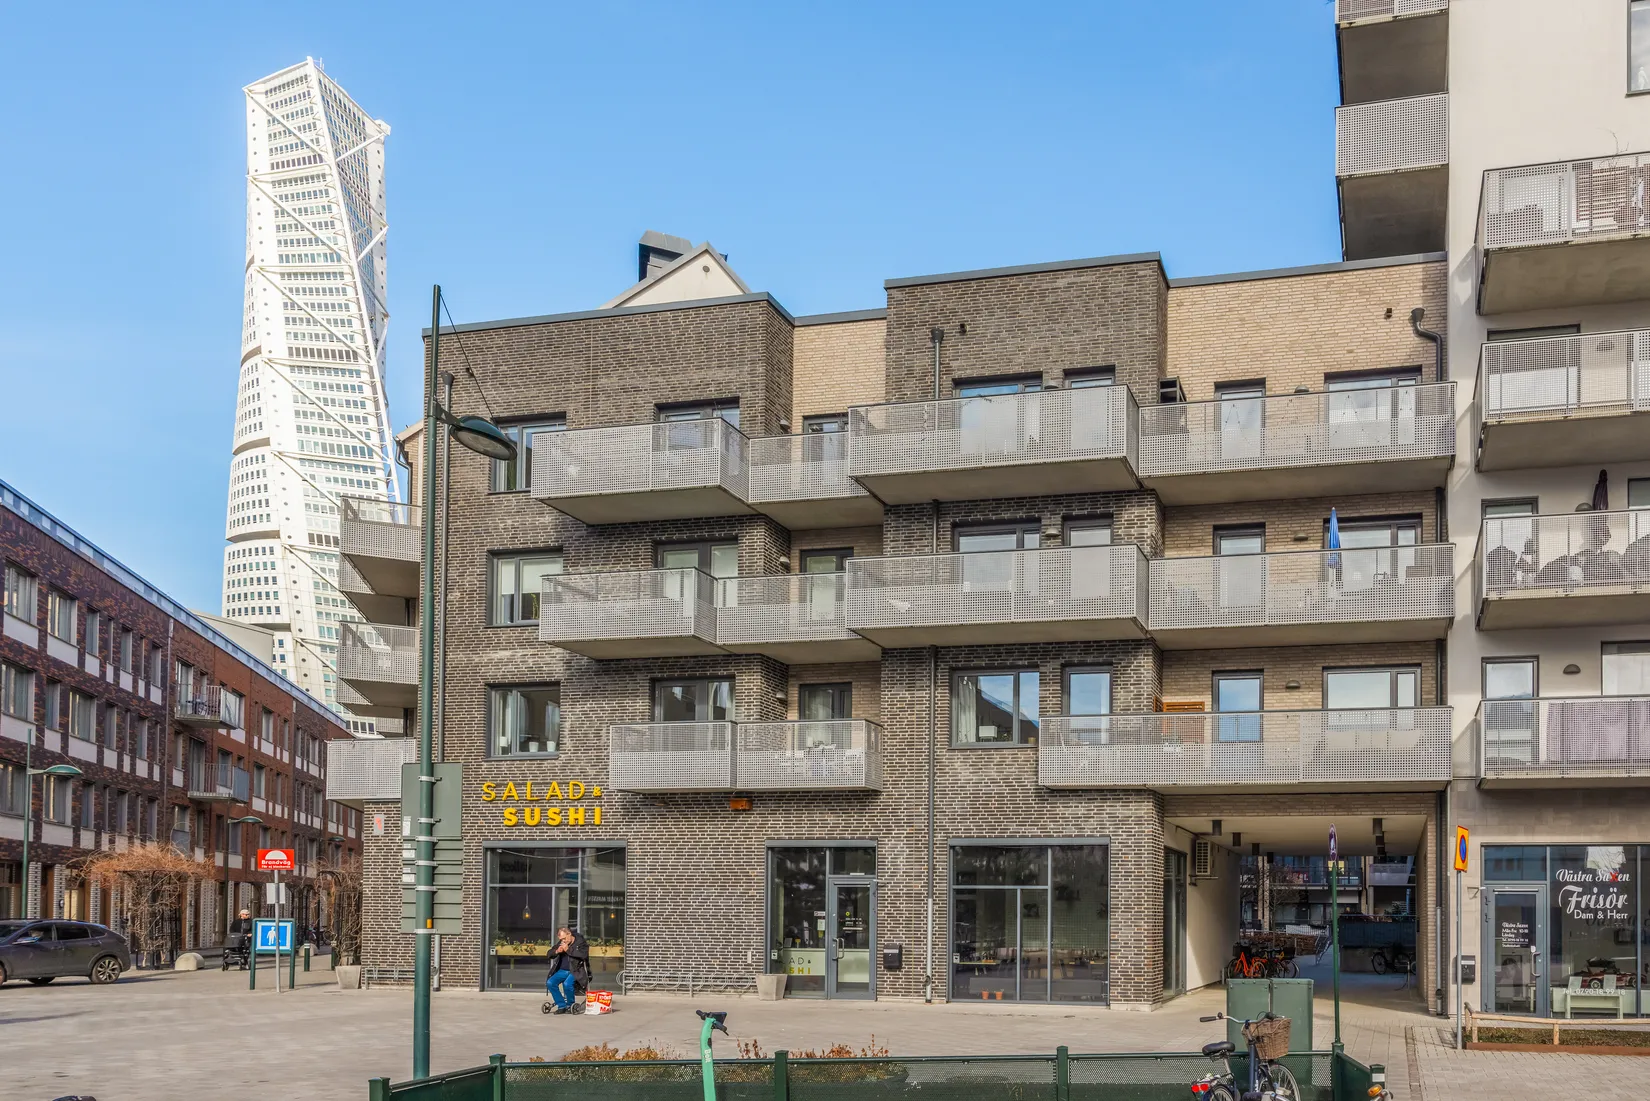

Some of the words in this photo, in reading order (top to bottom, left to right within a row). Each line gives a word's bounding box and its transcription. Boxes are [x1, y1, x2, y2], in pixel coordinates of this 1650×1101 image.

[481, 781, 586, 801] SALAD
[592, 785, 603, 798] &
[502, 807, 603, 827] SUSHI
[1555, 868, 1593, 882] Västra
[1595, 868, 1630, 882] Saxen
[1558, 885, 1628, 914] Frisör
[1574, 909, 1594, 919] Dam
[1597, 910, 1604, 919] &
[1607, 909, 1629, 919] Herr
